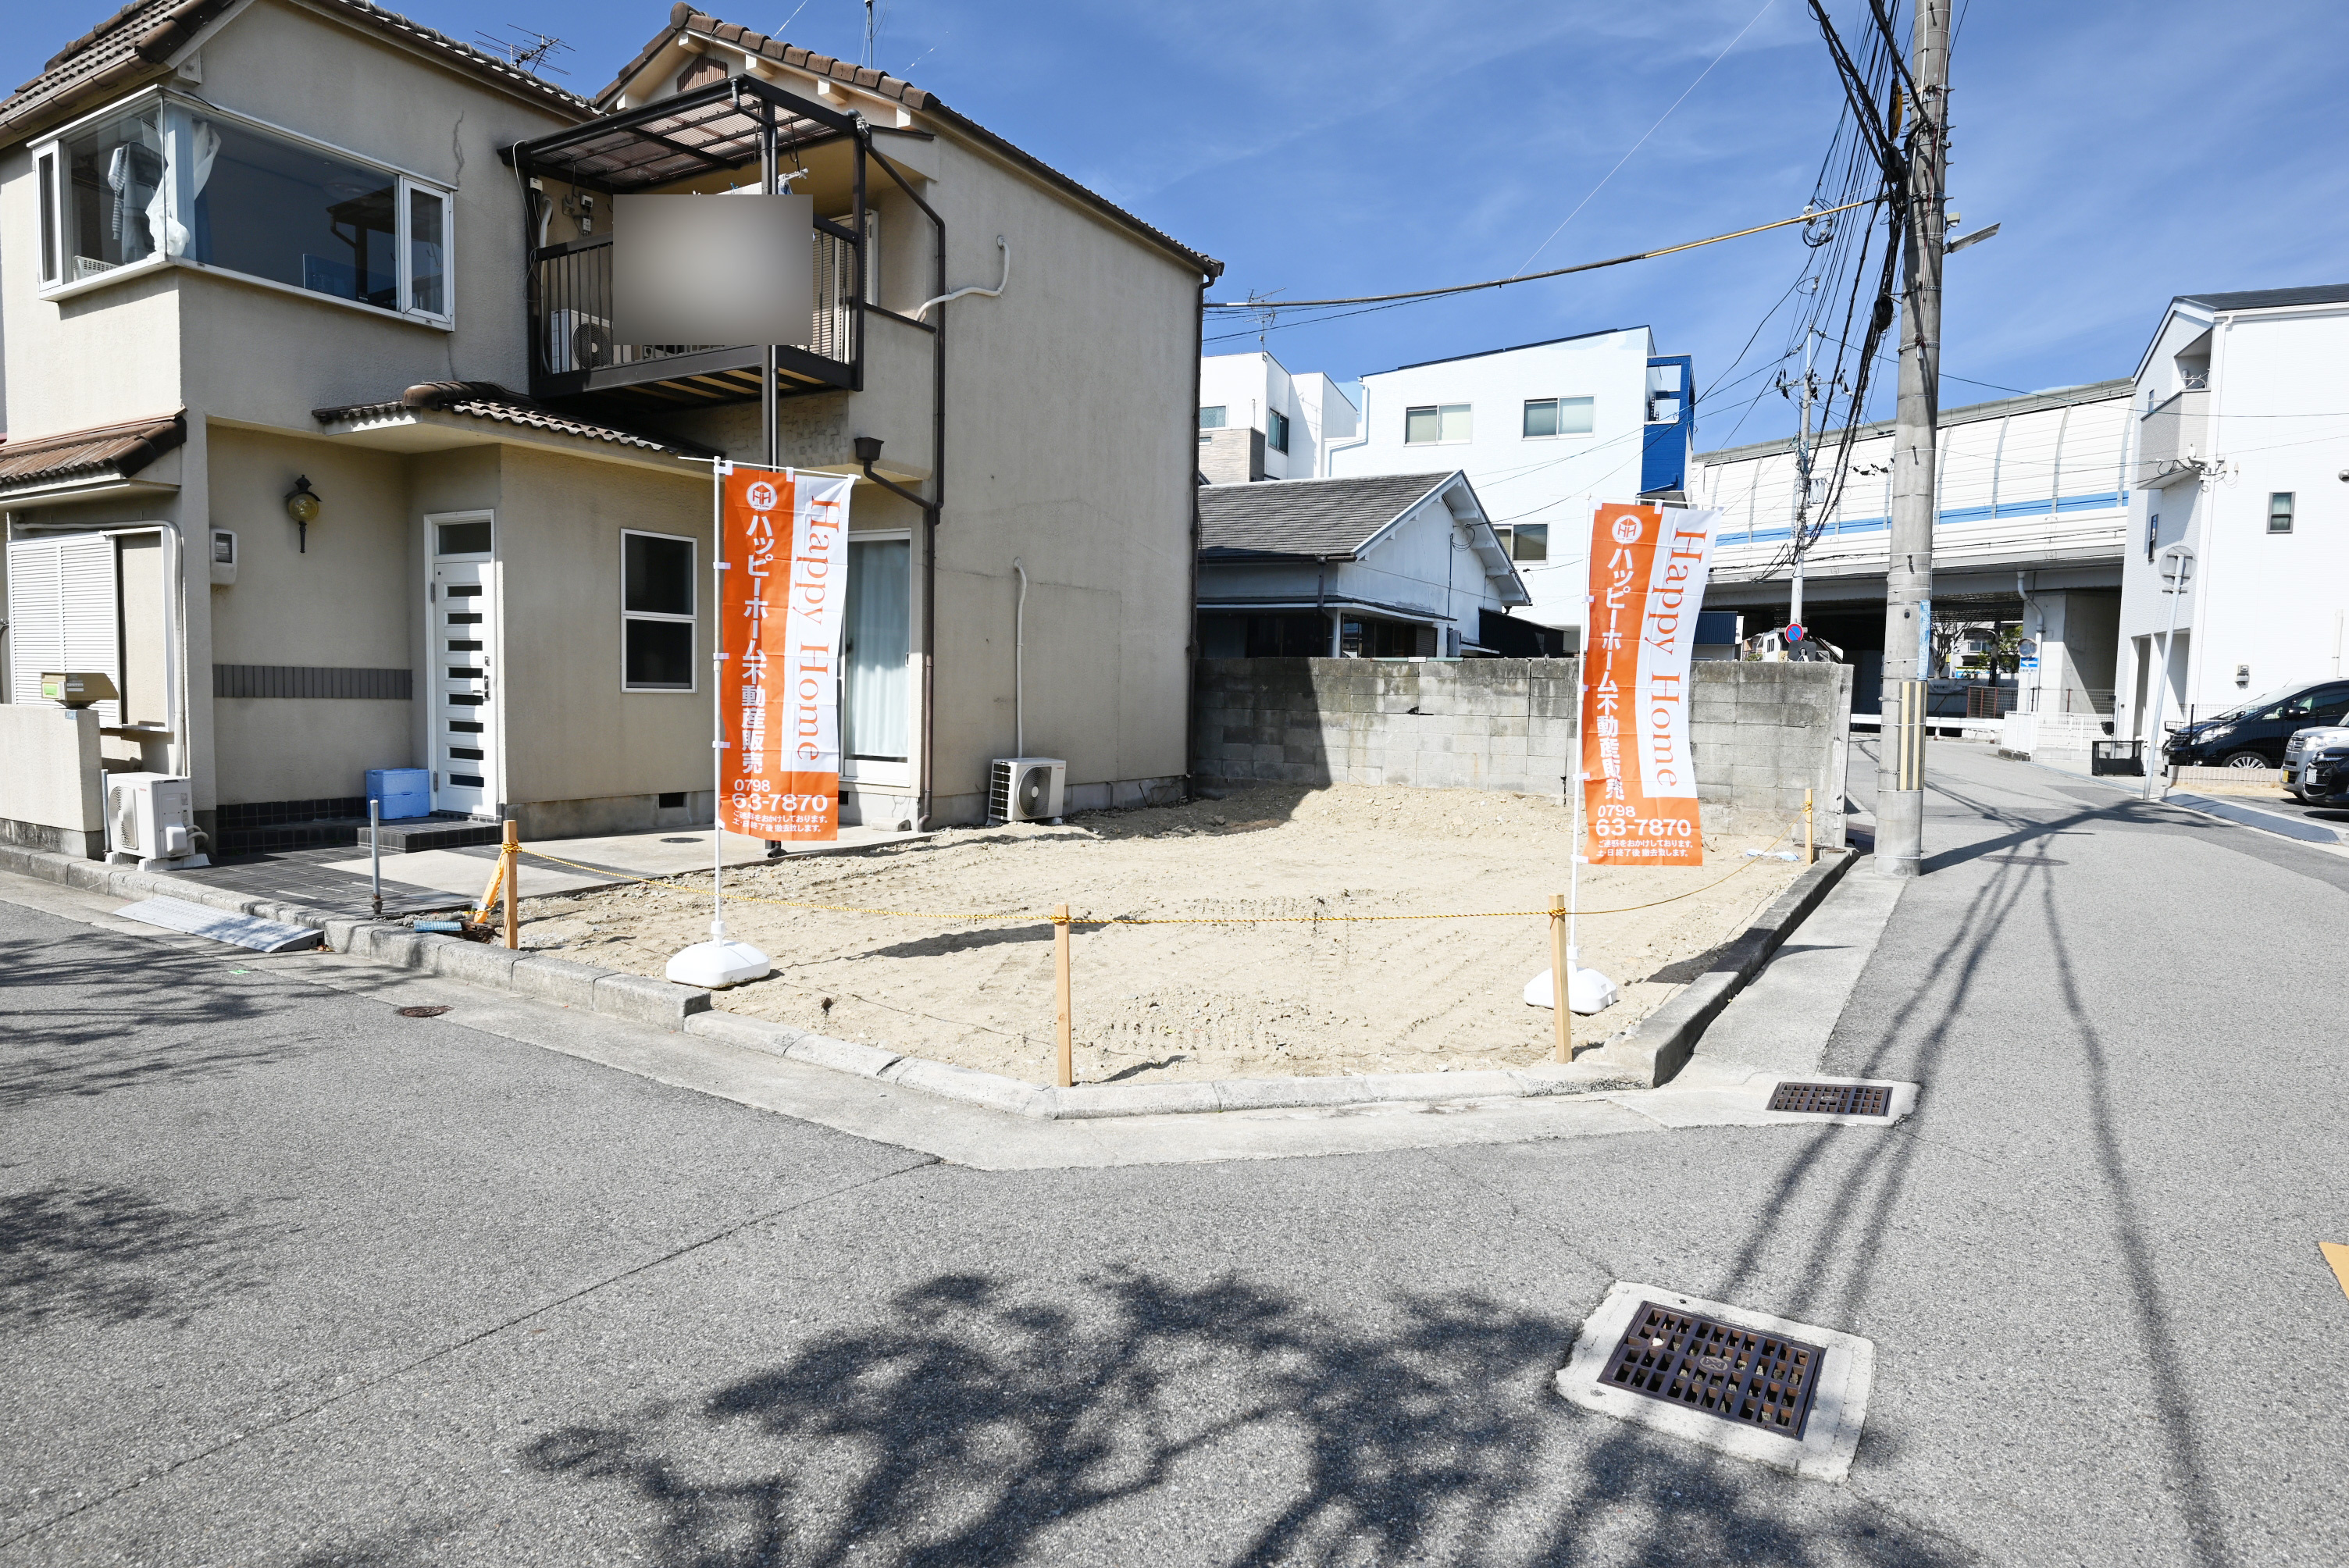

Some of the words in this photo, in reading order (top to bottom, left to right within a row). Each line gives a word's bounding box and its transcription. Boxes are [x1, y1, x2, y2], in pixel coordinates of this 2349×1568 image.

[793, 495, 841, 625] Happy
[1645, 527, 1707, 655] Happy
[741, 515, 775, 774] ハッピーホーム不動産販売
[797, 641, 829, 761] Home
[1597, 548, 1634, 800] ハッピーホーム不動産販売
[734, 779, 771, 793] 0798
[1651, 671, 1681, 786] Home
[732, 793, 828, 812] 63-7870
[1595, 818, 1691, 837] 63-7870
[1597, 804, 1636, 818] 0798
[1598, 839, 1693, 848] ご迷惑をおかけしております。
